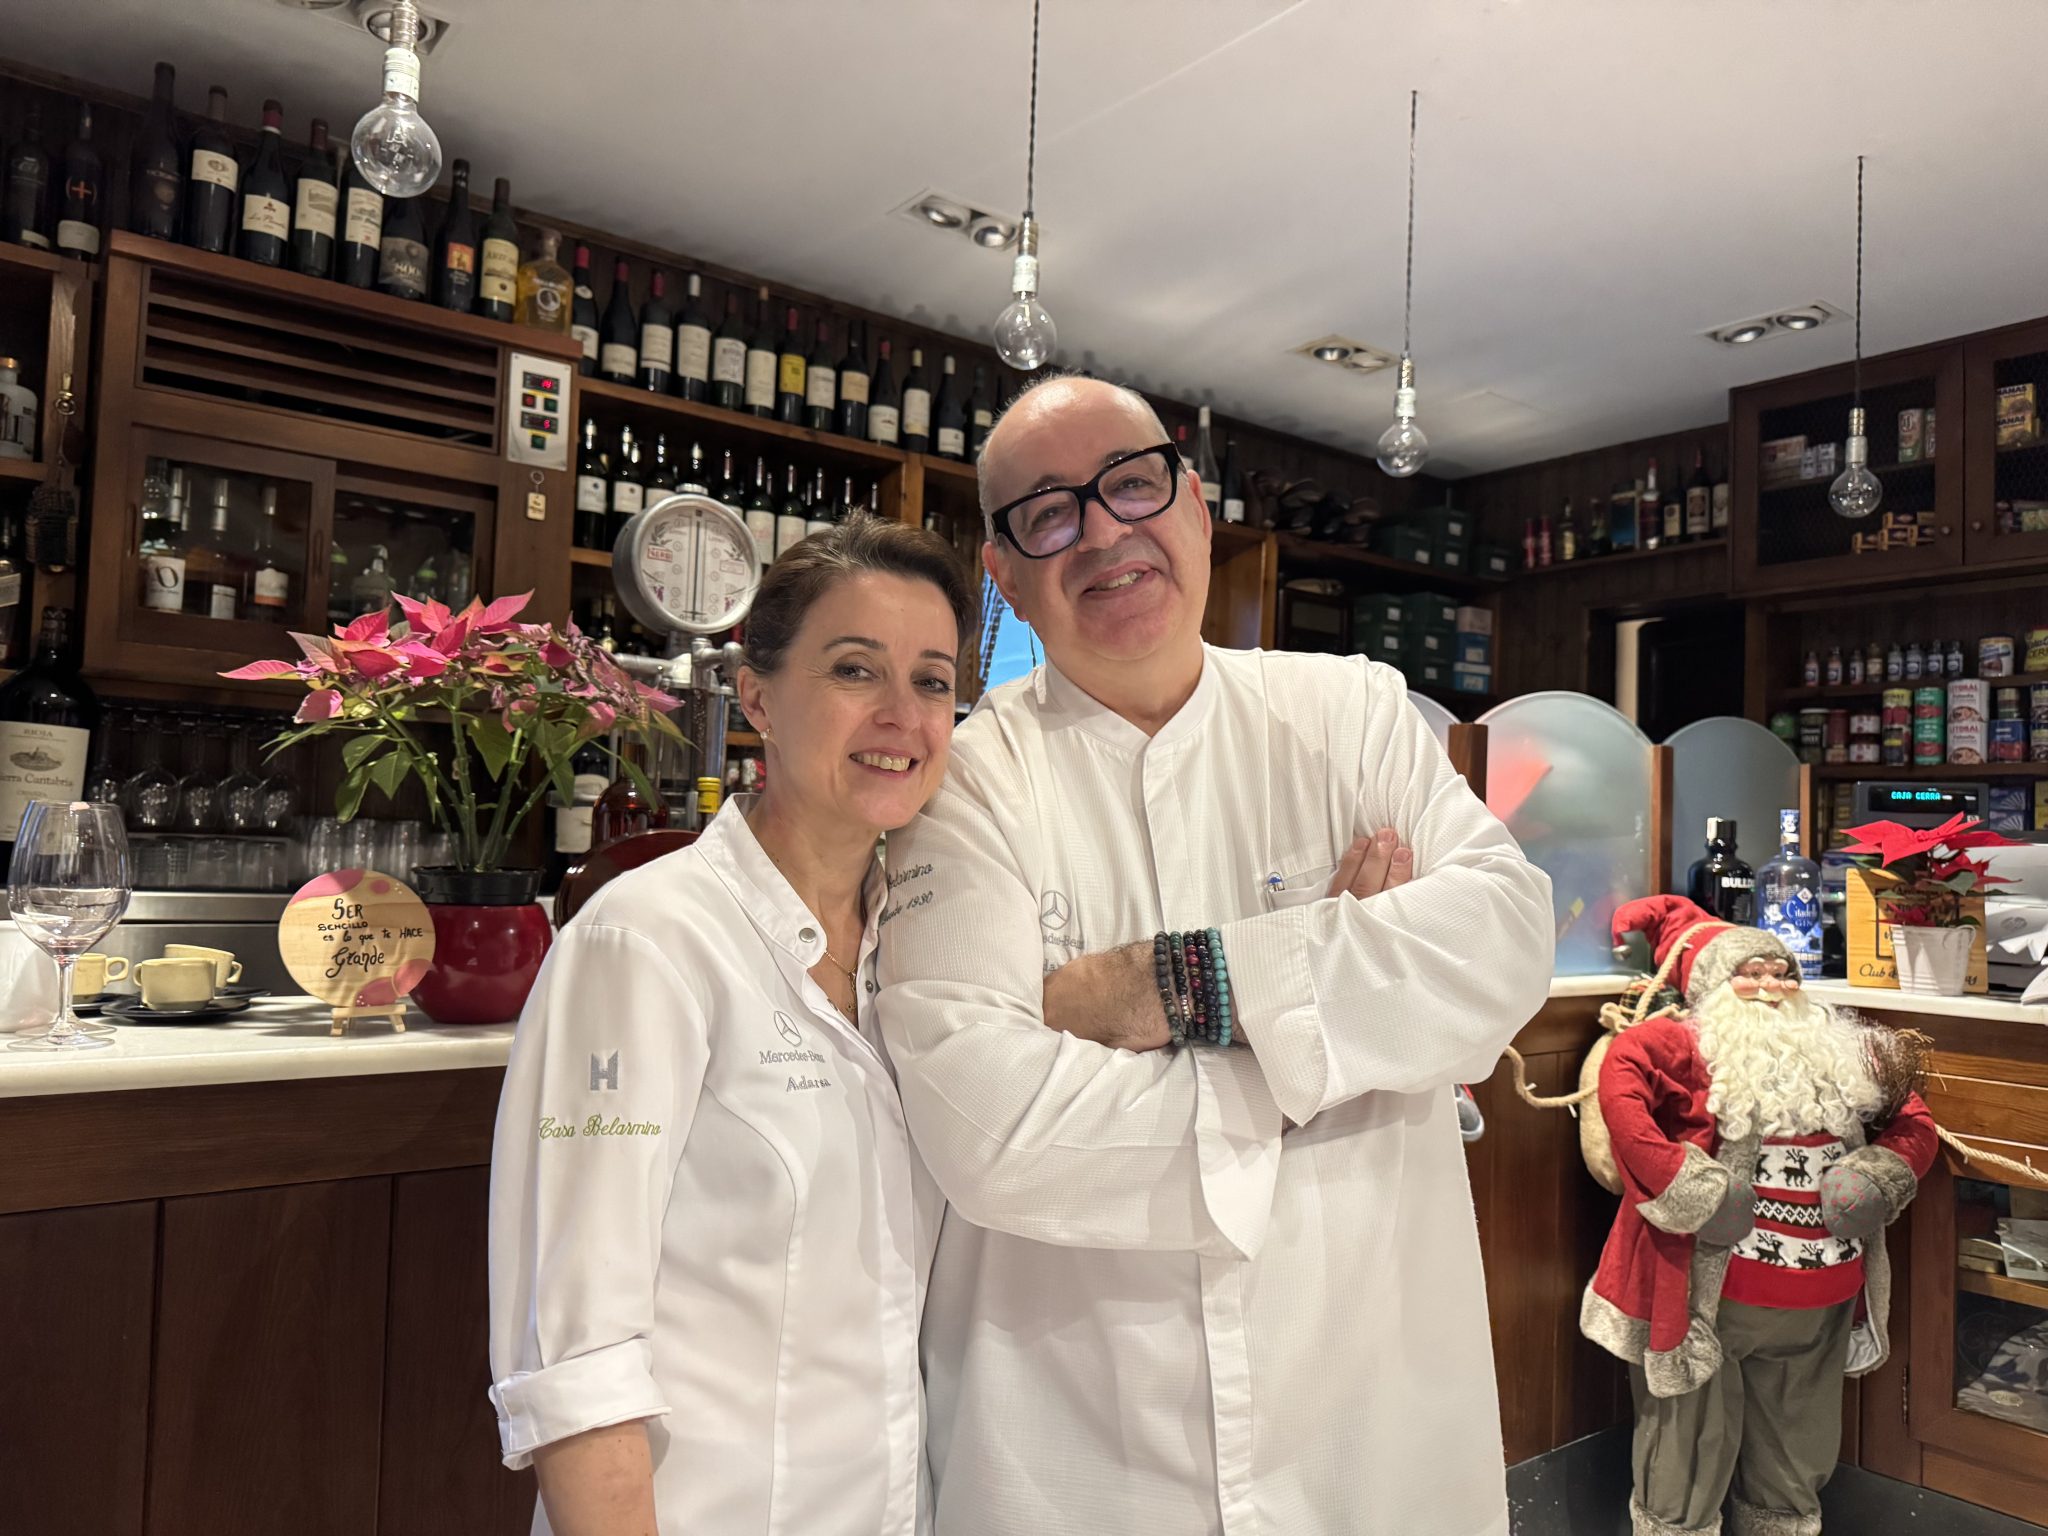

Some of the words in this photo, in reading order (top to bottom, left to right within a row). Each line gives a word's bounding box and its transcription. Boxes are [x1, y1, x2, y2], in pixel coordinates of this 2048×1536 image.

[23, 728, 53, 737] RIOJA
[0, 774, 22, 782] erra
[25, 773, 74, 787] Cantabria
[1891, 791, 1912, 800] CAJA
[331, 898, 364, 920] SER
[343, 931, 352, 943] lo
[359, 933, 375, 946] que
[399, 927, 423, 939] HACE
[325, 945, 385, 979] Grande
[1860, 964, 1885, 977] Club
[539, 1117, 576, 1140] Casa
[582, 1113, 662, 1137] Belarmino
